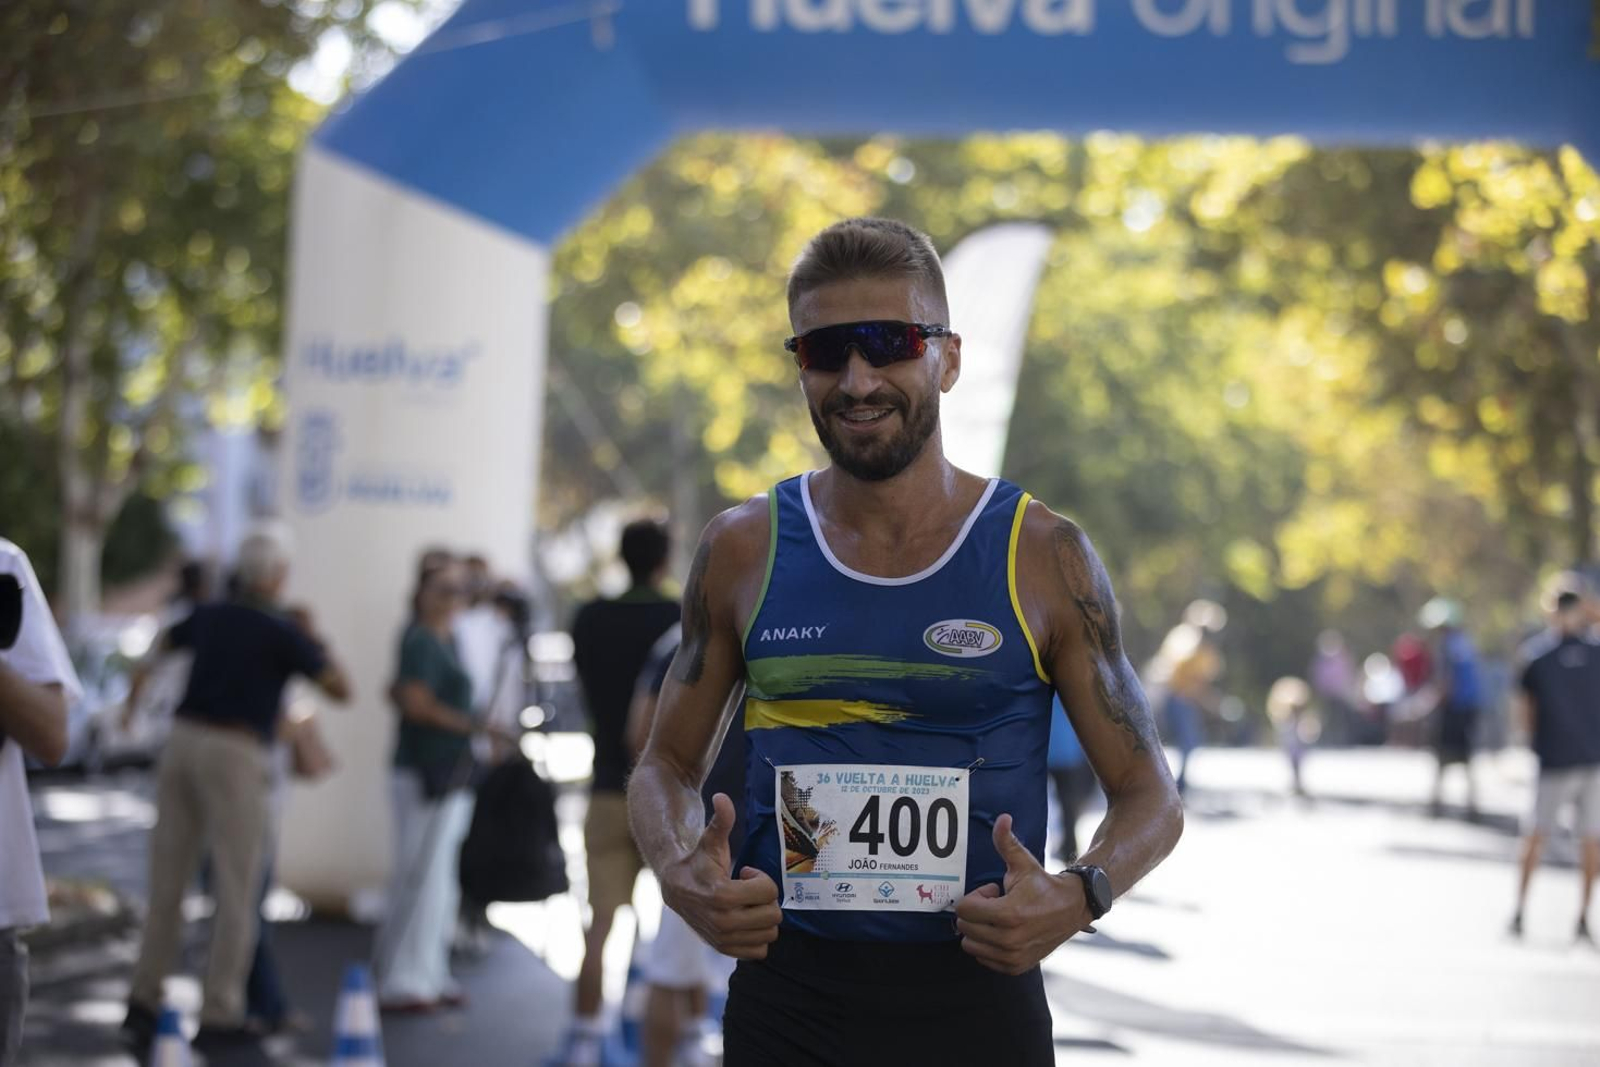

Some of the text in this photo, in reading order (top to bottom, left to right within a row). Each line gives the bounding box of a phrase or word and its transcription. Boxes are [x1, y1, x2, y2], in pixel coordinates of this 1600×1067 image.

[760, 625, 828, 642] ANAKY
[950, 629, 985, 647] AABV
[817, 772, 957, 788] 36 VUELTA A HUELVA
[841, 785, 848, 793] 12
[850, 785, 860, 793] DE
[862, 785, 897, 794] OCTUBRE
[912, 787, 930, 795] 2023
[849, 795, 958, 859] 400
[848, 858, 919, 871] JOÃO FERNANDES
